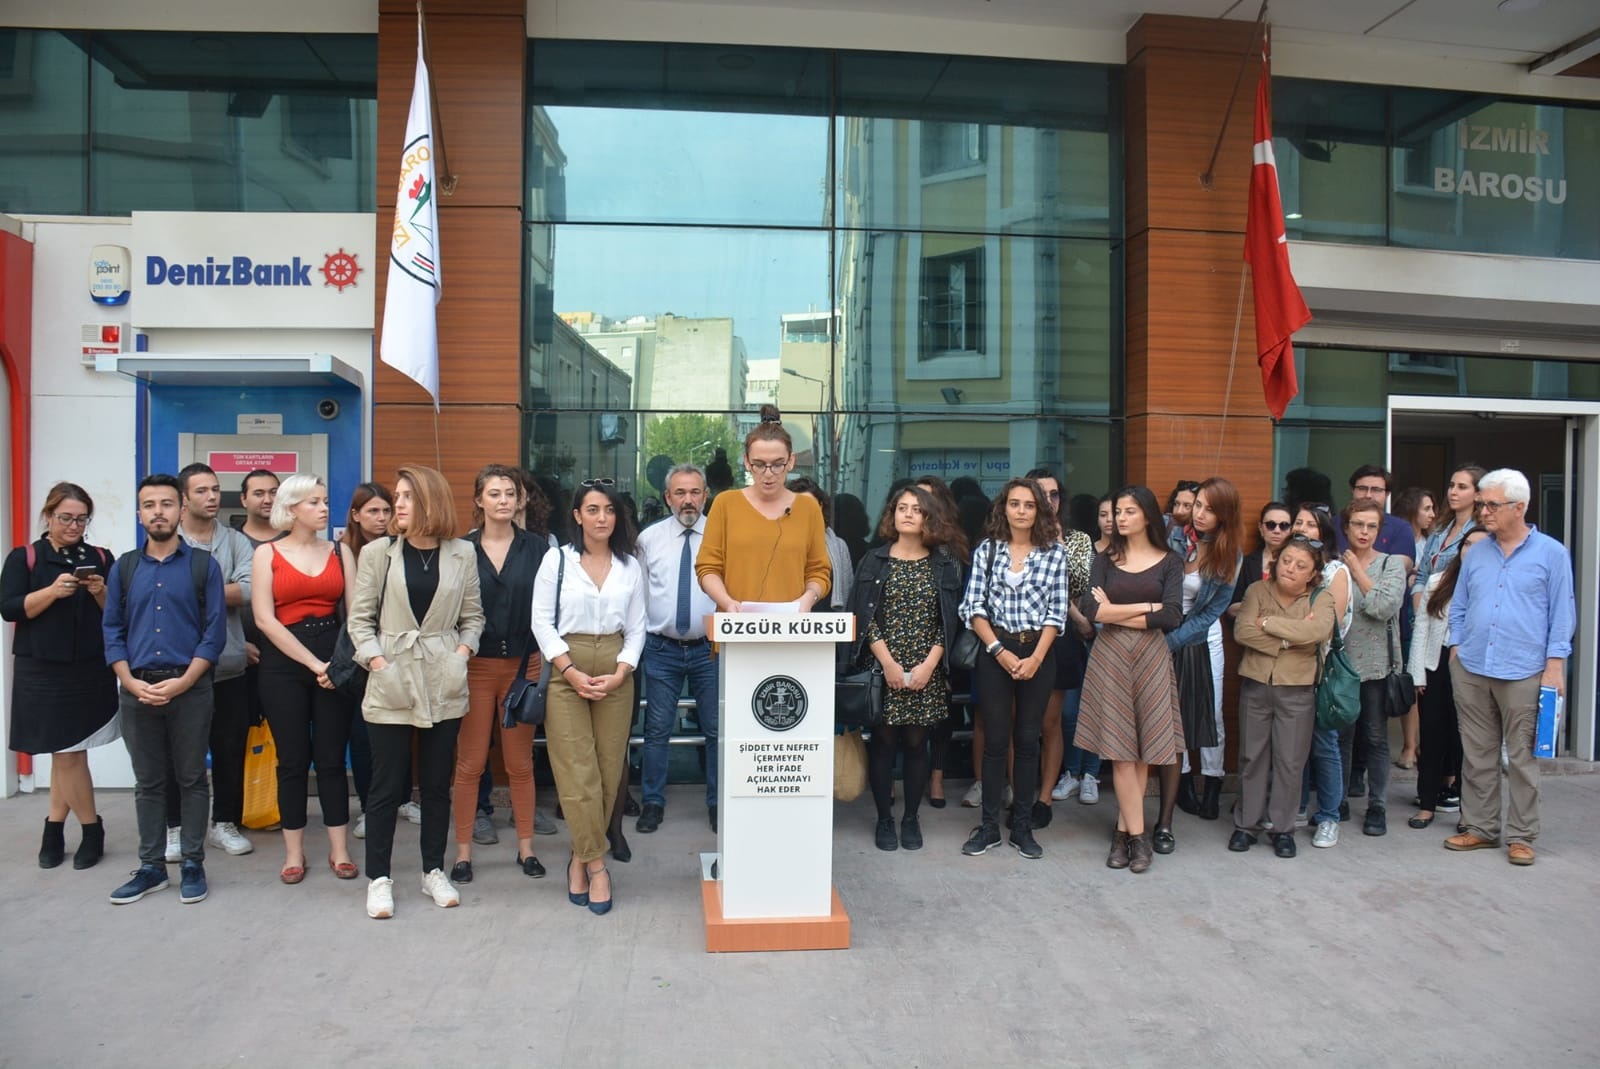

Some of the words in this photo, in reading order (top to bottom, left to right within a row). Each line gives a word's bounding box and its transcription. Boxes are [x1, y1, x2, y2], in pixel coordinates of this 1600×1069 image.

[1459, 118, 1550, 155] İZMİR
[1434, 167, 1567, 204] BAROSU
[146, 256, 312, 286] DenizBank
[721, 618, 782, 635] ÖZGÜR
[789, 618, 847, 635] KÜRSÜ
[739, 742, 771, 753] ŞİDDET
[773, 743, 784, 752] VE
[786, 743, 819, 752] NEFRET
[753, 753, 805, 764] İÇERMEYEN
[756, 764, 774, 773] HER
[776, 763, 802, 773] İFADE
[747, 774, 811, 785] AÇIKLANMAYI
[757, 785, 776, 794] HAK
[779, 785, 801, 793] EDER
